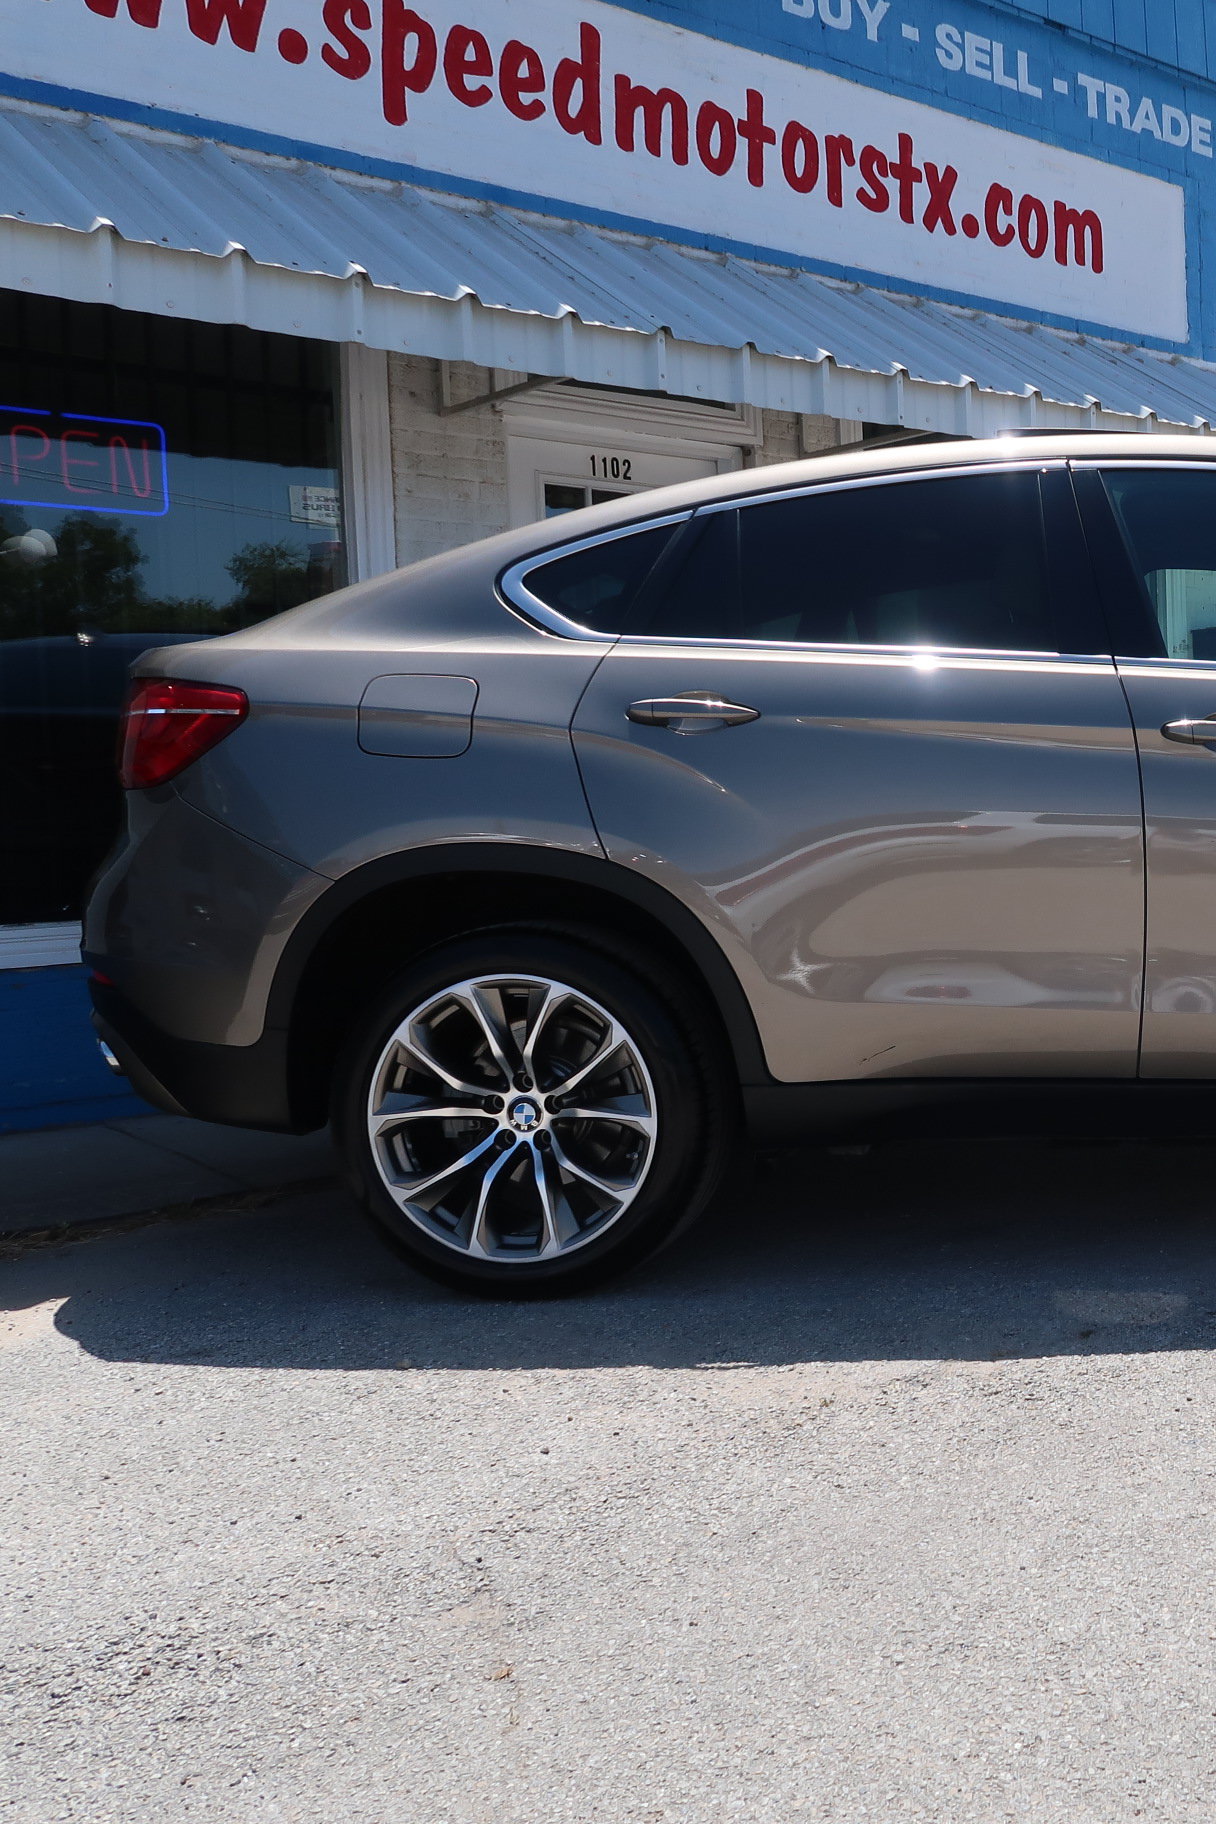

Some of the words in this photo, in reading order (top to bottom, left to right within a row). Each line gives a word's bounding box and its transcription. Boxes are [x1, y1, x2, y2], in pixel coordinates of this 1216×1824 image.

[935, 22, 1042, 99] SELL
[1077, 72, 1213, 158] TRADE
[0, 424, 151, 498] PEN
[590, 454, 632, 480] 1102
